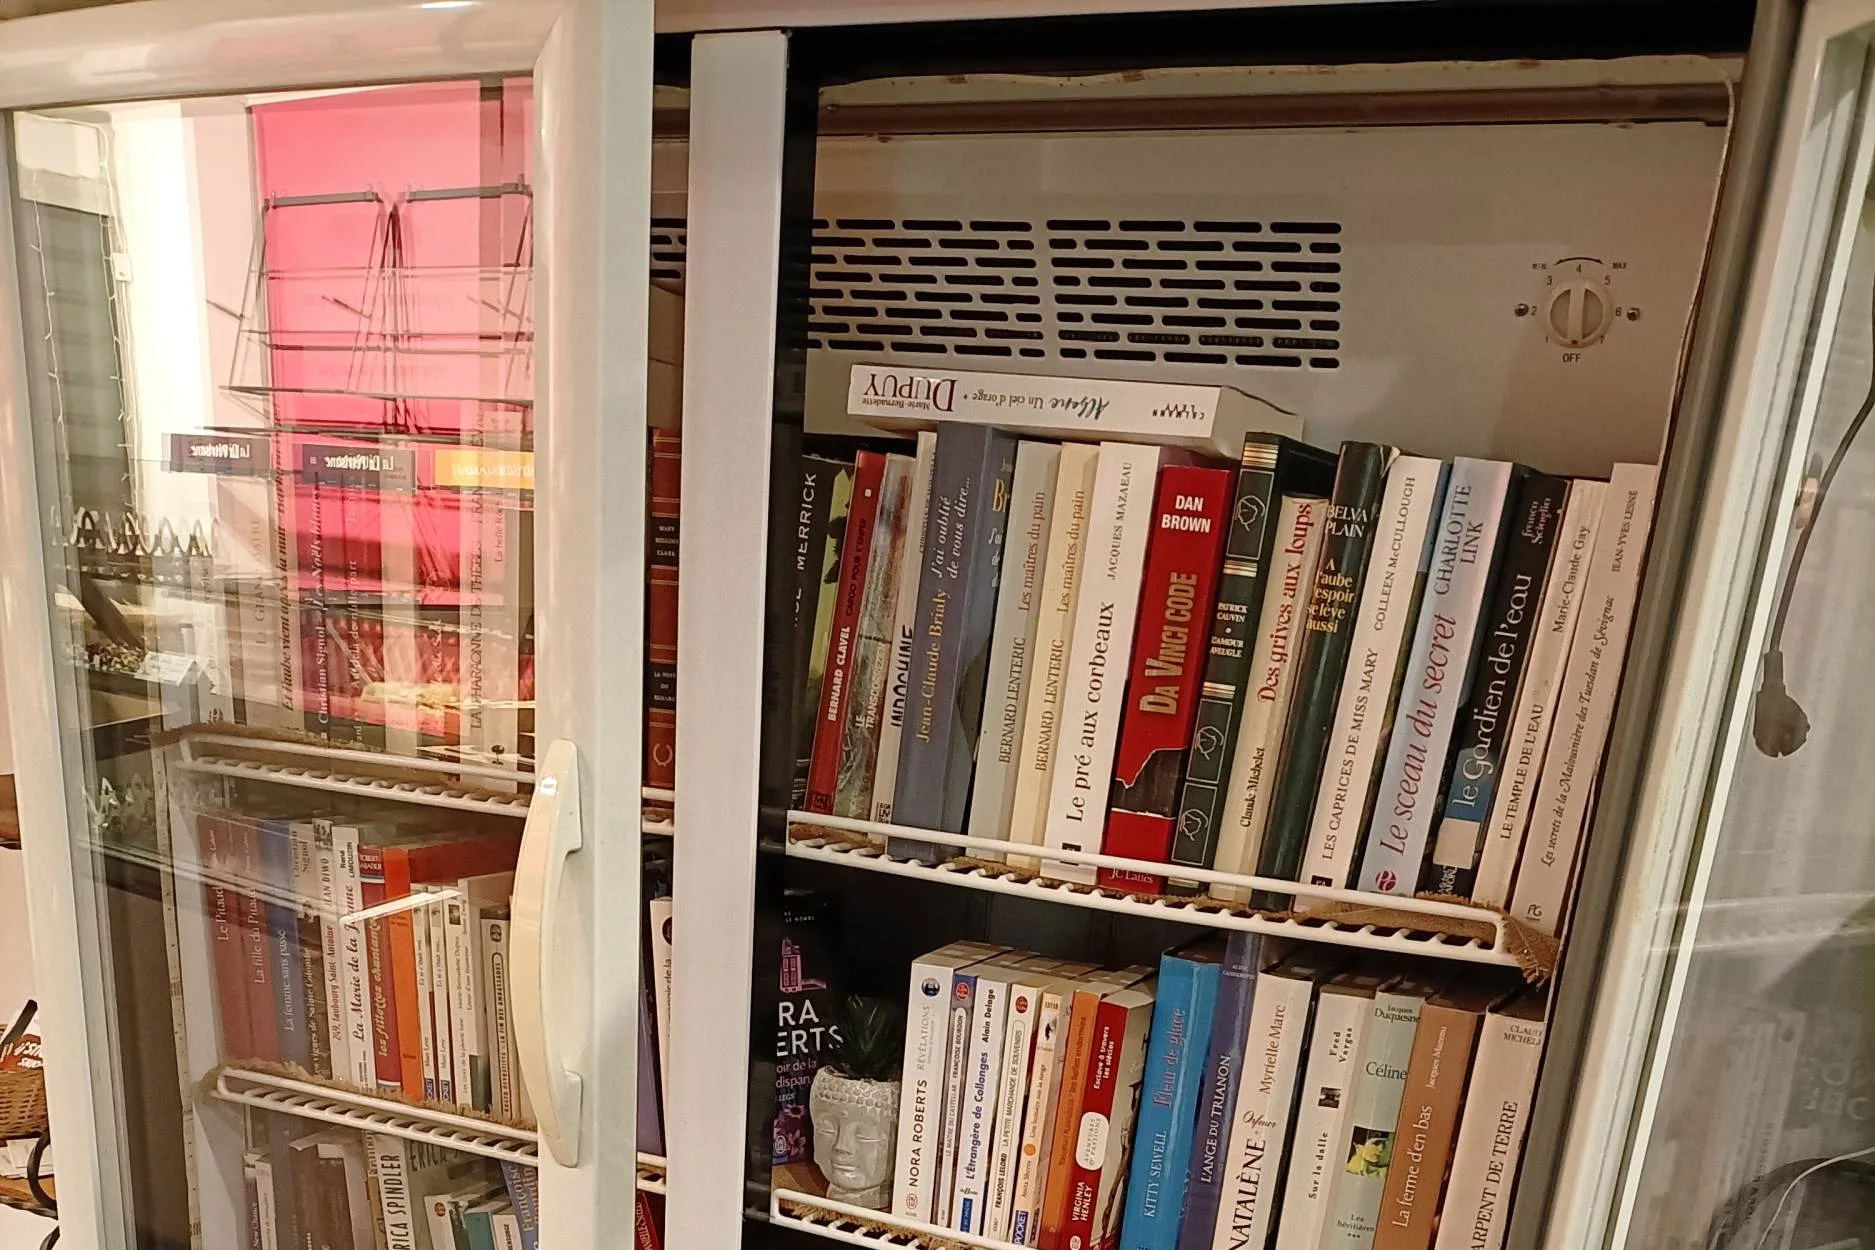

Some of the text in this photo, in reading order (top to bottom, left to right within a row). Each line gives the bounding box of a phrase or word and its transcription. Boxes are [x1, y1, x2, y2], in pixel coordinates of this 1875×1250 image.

[1546, 275, 1552, 285] 3
[1576, 264, 1582, 273] 4
[1604, 275, 1611, 286] 5
[1531, 306, 1537, 315] 2
[1615, 307, 1622, 317] 6
[1562, 353, 1582, 363] OFF
[864, 374, 959, 412] DUPUY
[797, 472, 817, 572] MERRICK
[1107, 462, 1132, 581] JACQUES MAZAEAU
[1161, 513, 1212, 533] BROWN
[1175, 495, 1204, 512] DAN
[1325, 520, 1365, 538] PLAIN
[1327, 505, 1368, 523] BELVA
[1433, 484, 1472, 596] CHARLOTTE
[1460, 519, 1484, 565] LINK
[1258, 503, 1315, 703] Des grives aux loups
[1552, 525, 1591, 634] Marie-Claude Gay
[1217, 612, 1245, 623] CAUVIN
[1218, 602, 1248, 614] PATRICK
[1307, 618, 1338, 633] aussi
[1086, 601, 1116, 707] corbeaux
[1139, 572, 1198, 716] DA VINCI CODE
[316, 626, 329, 725] Christian Signol
[828, 626, 850, 721] BERNARD CLAVEL
[999, 637, 1027, 765] BERNARD LENTERIC
[1461, 573, 1533, 808] le Gardien de l'eau
[1035, 637, 1066, 773] BERNARD LENTERIC
[1082, 711, 1099, 750] aux
[1322, 647, 1379, 861] LES CAPRICES DE MISS MARY
[1380, 612, 1457, 858] Le sceau du secret
[1072, 753, 1094, 791] pré
[1501, 702, 1544, 841] LE TEMPLE DE L'EAU
[1064, 795, 1084, 824] Le
[215, 886, 229, 942] Le Pitaud
[349, 936, 365, 1041] La Marie de la
[983, 988, 995, 1044] Alain Delage
[1374, 1008, 1421, 1024] Duquesne
[375, 998, 389, 1057] les fillettes
[1258, 1004, 1286, 1095] Myrielle Marc
[1328, 1030, 1342, 1058] Fred
[1338, 1026, 1353, 1064] Vargas
[1366, 1061, 1408, 1081] Céline
[909, 1079, 928, 1188] NORA ROBERTS
[965, 1051, 989, 1181] L'Étrangère de Collonges
[1200, 1054, 1232, 1184] L'ANGE DU TRIANON
[1492, 1100, 1519, 1158] TERRE
[381, 1153, 406, 1216] SPINDLER
[1144, 1130, 1167, 1218] KITTY SEWELL
[1308, 1131, 1328, 1200] Sur la dalle
[1486, 1160, 1503, 1186] DE
[1014, 1211, 1027, 1245] POCKET
[1071, 1181, 1085, 1222] VIRGINIA
[1079, 1185, 1093, 1222] HENLEY
